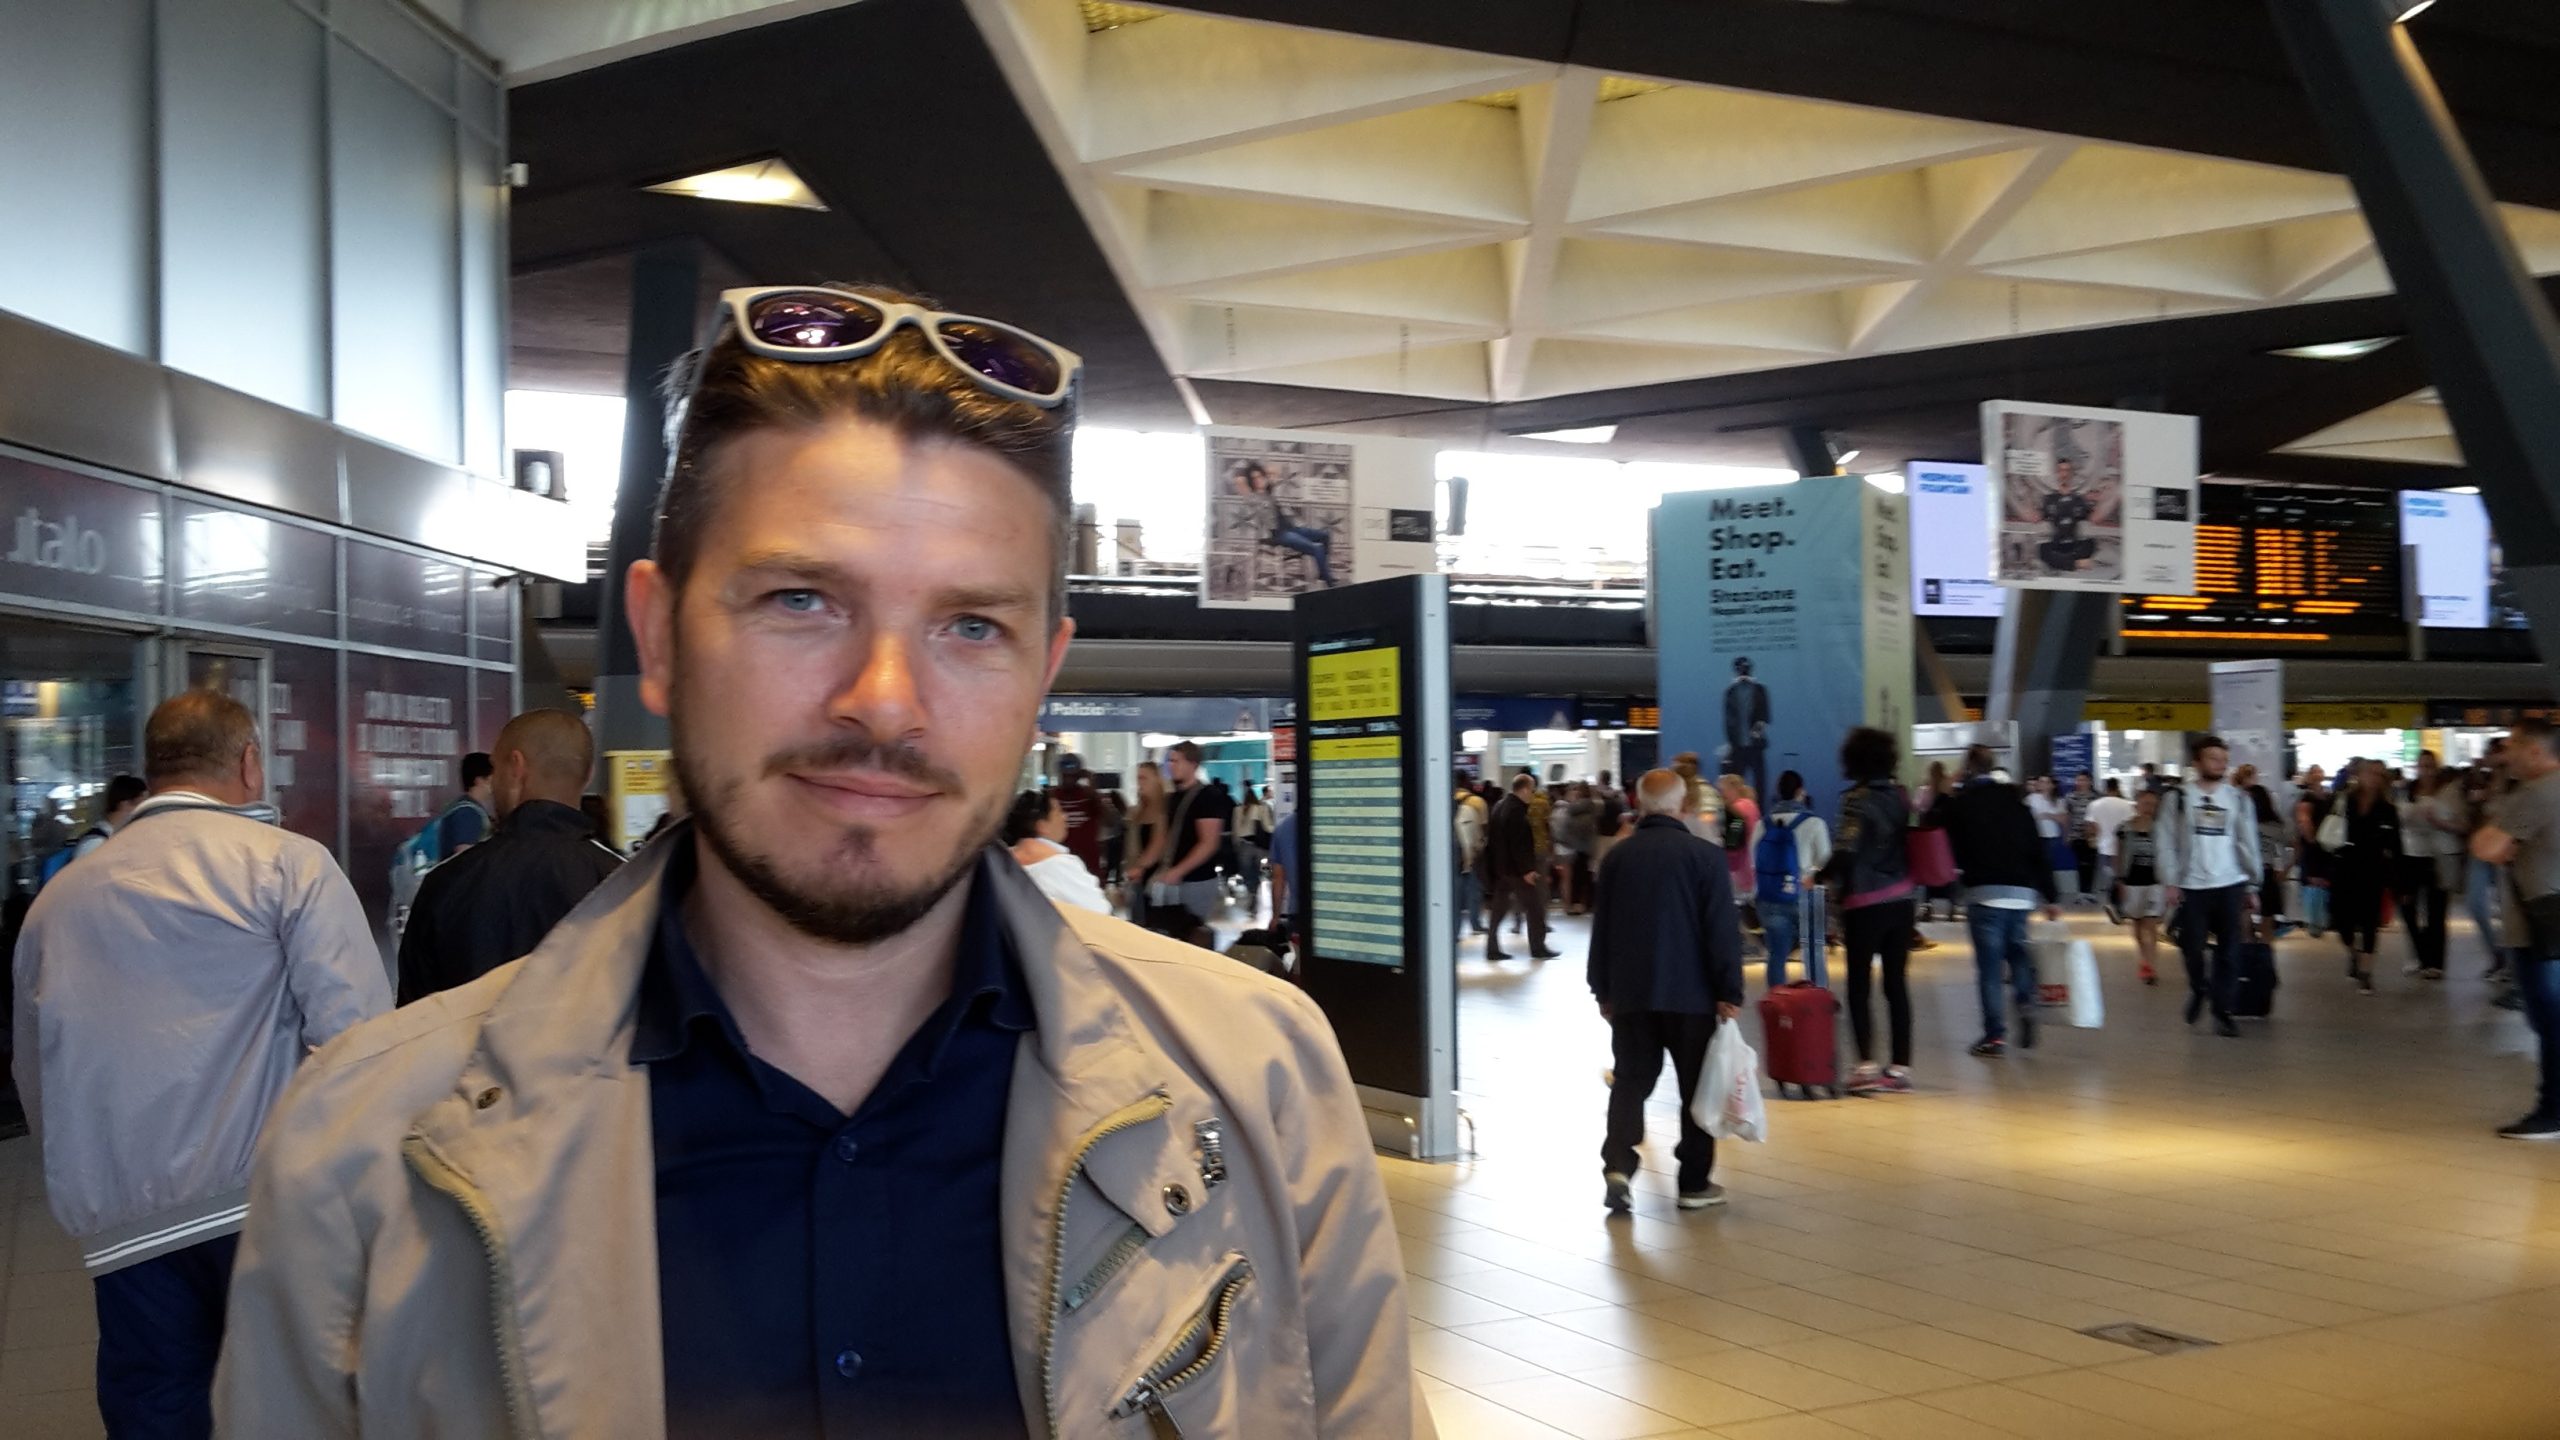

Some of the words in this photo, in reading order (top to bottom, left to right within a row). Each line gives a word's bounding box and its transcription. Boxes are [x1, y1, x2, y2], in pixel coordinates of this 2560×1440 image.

[1709, 497, 1795, 521] Meet.
[1709, 526, 1795, 554] Shop.
[1709, 557, 1767, 579] Eat.
